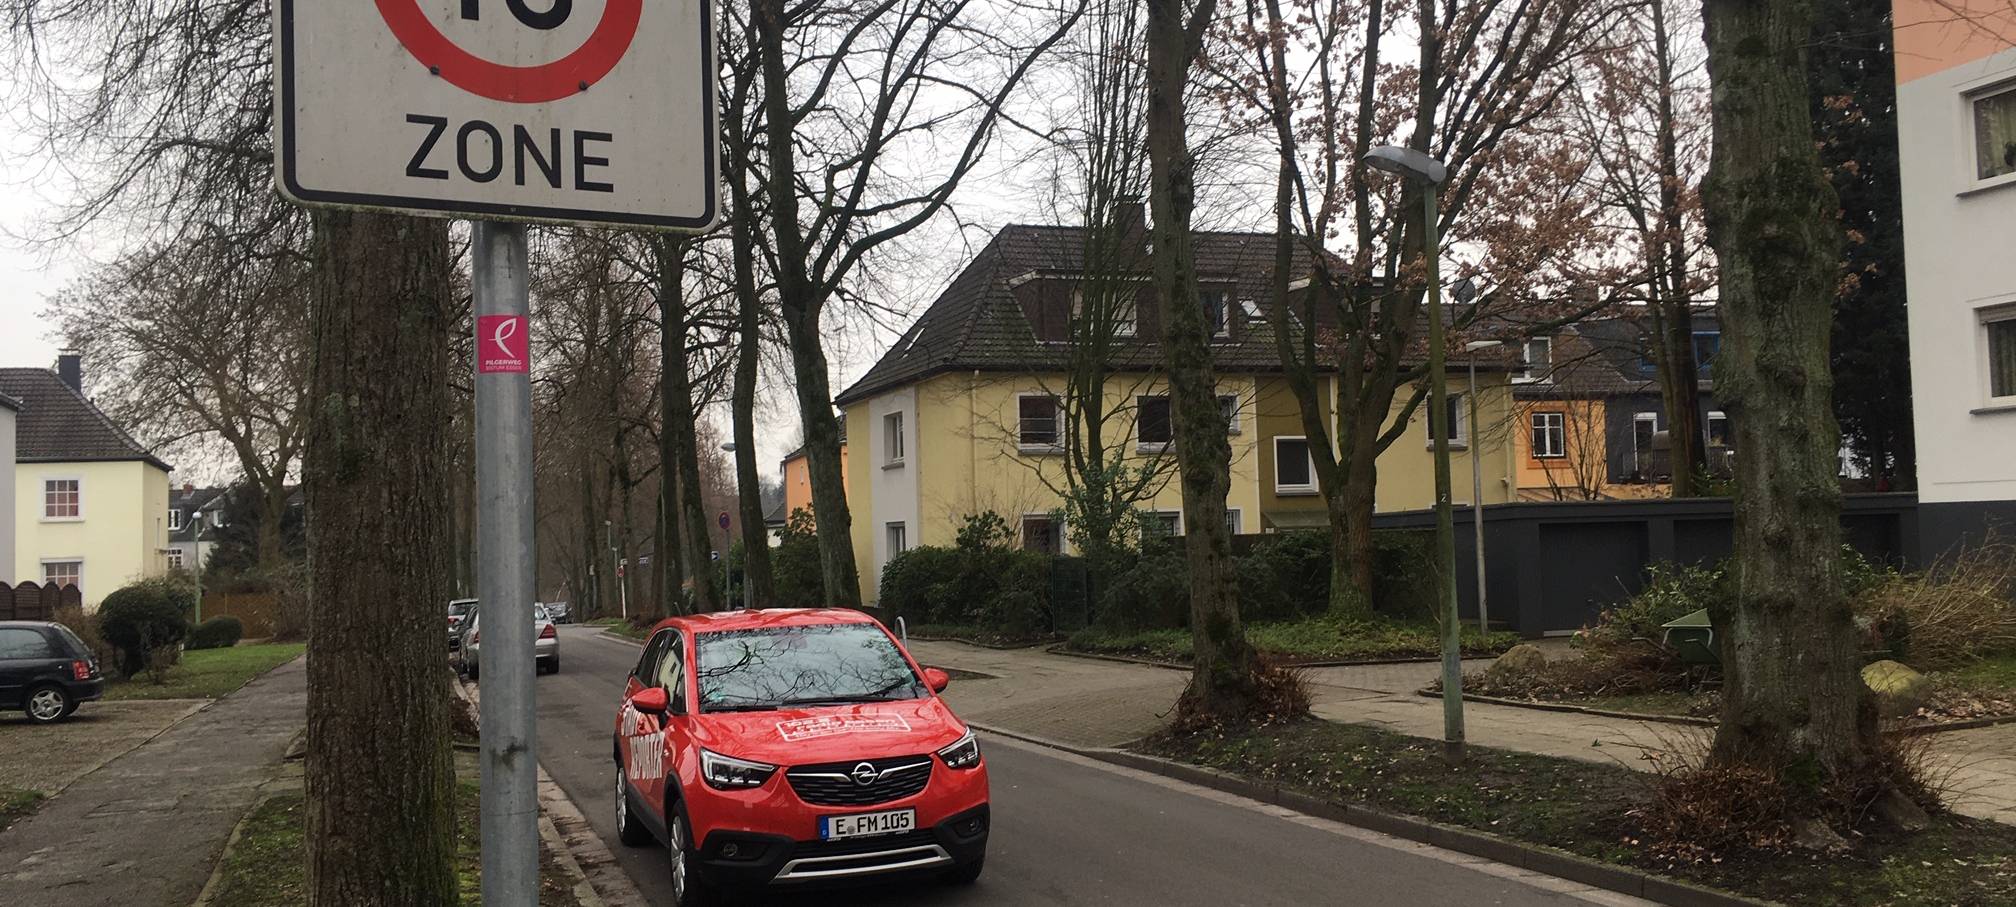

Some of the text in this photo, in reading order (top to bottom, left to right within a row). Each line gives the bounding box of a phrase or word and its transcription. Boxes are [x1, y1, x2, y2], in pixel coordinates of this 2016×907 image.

[406, 113, 614, 193] ZONE
[836, 819, 846, 835] E
[857, 815, 878, 833] FM
[881, 812, 909, 830] 105
